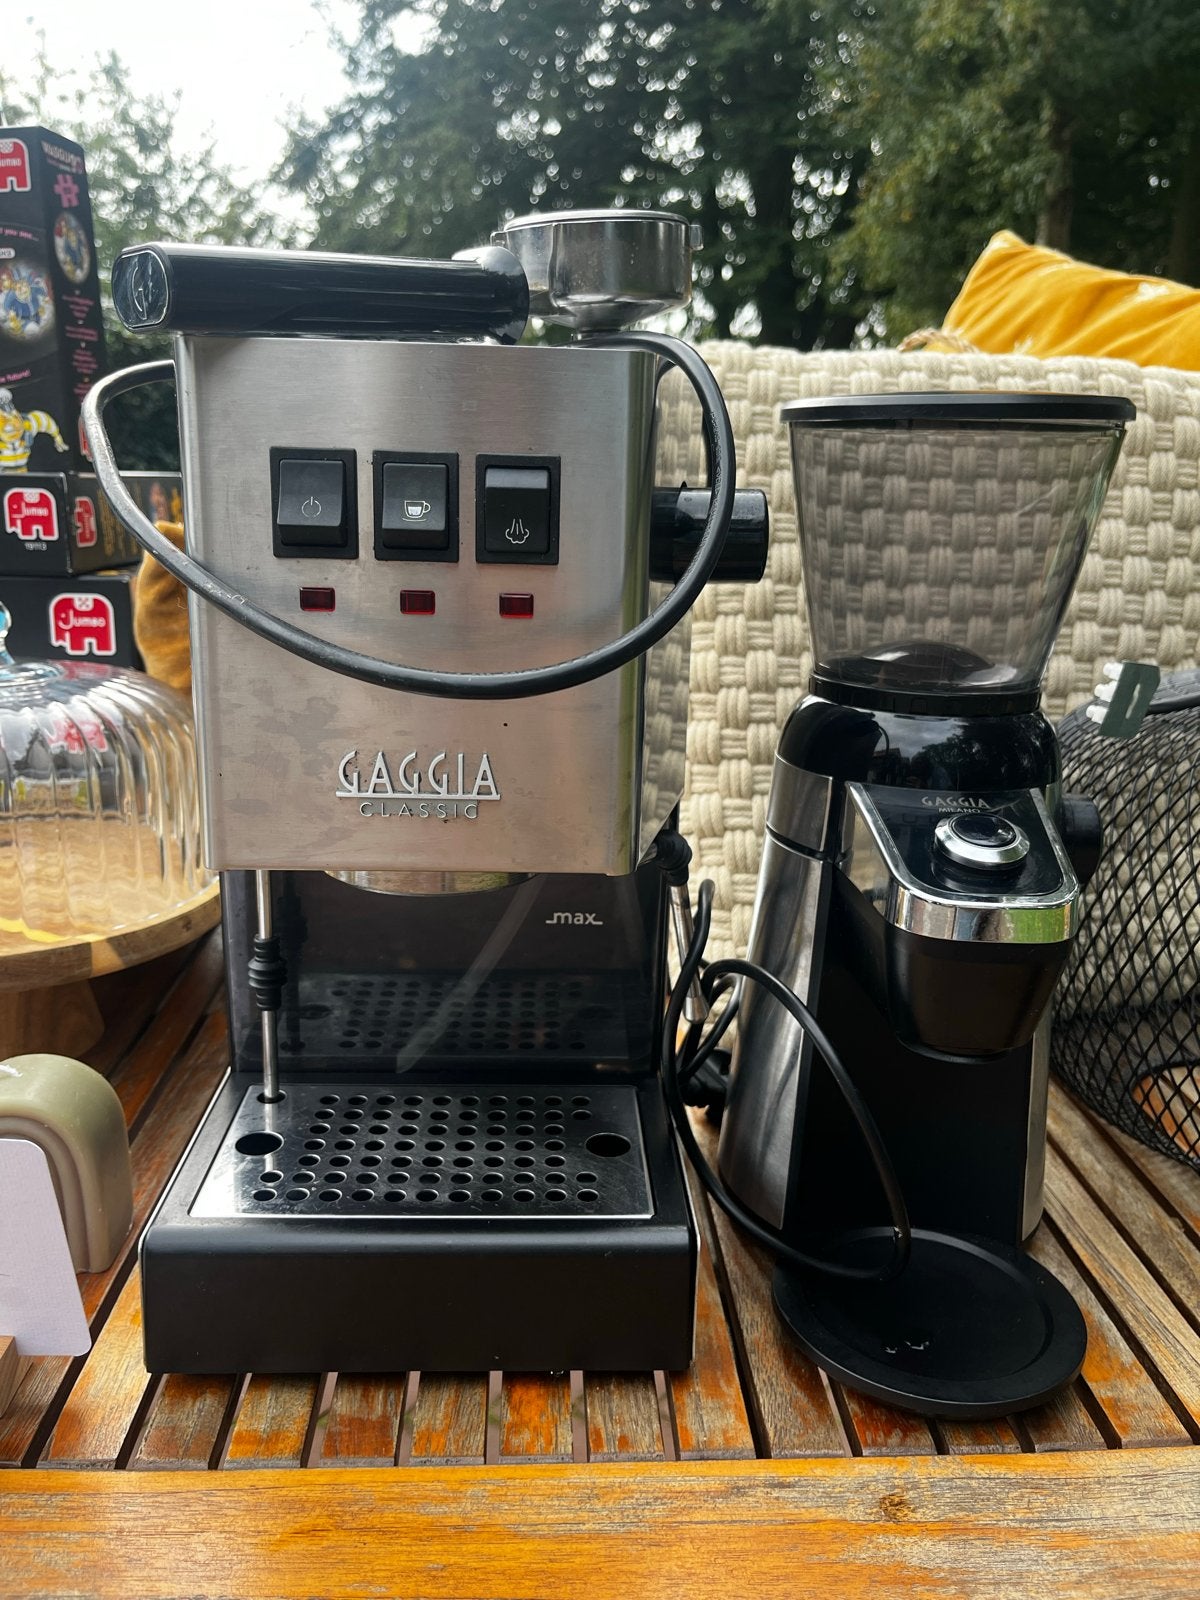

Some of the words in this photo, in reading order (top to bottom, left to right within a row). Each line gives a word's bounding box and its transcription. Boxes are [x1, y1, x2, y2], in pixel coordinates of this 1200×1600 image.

[336, 750, 500, 800] GAGGIA
[921, 796, 991, 809] GAGGIA
[359, 802, 478, 819] CLASSIC
[550, 912, 599, 925] max
